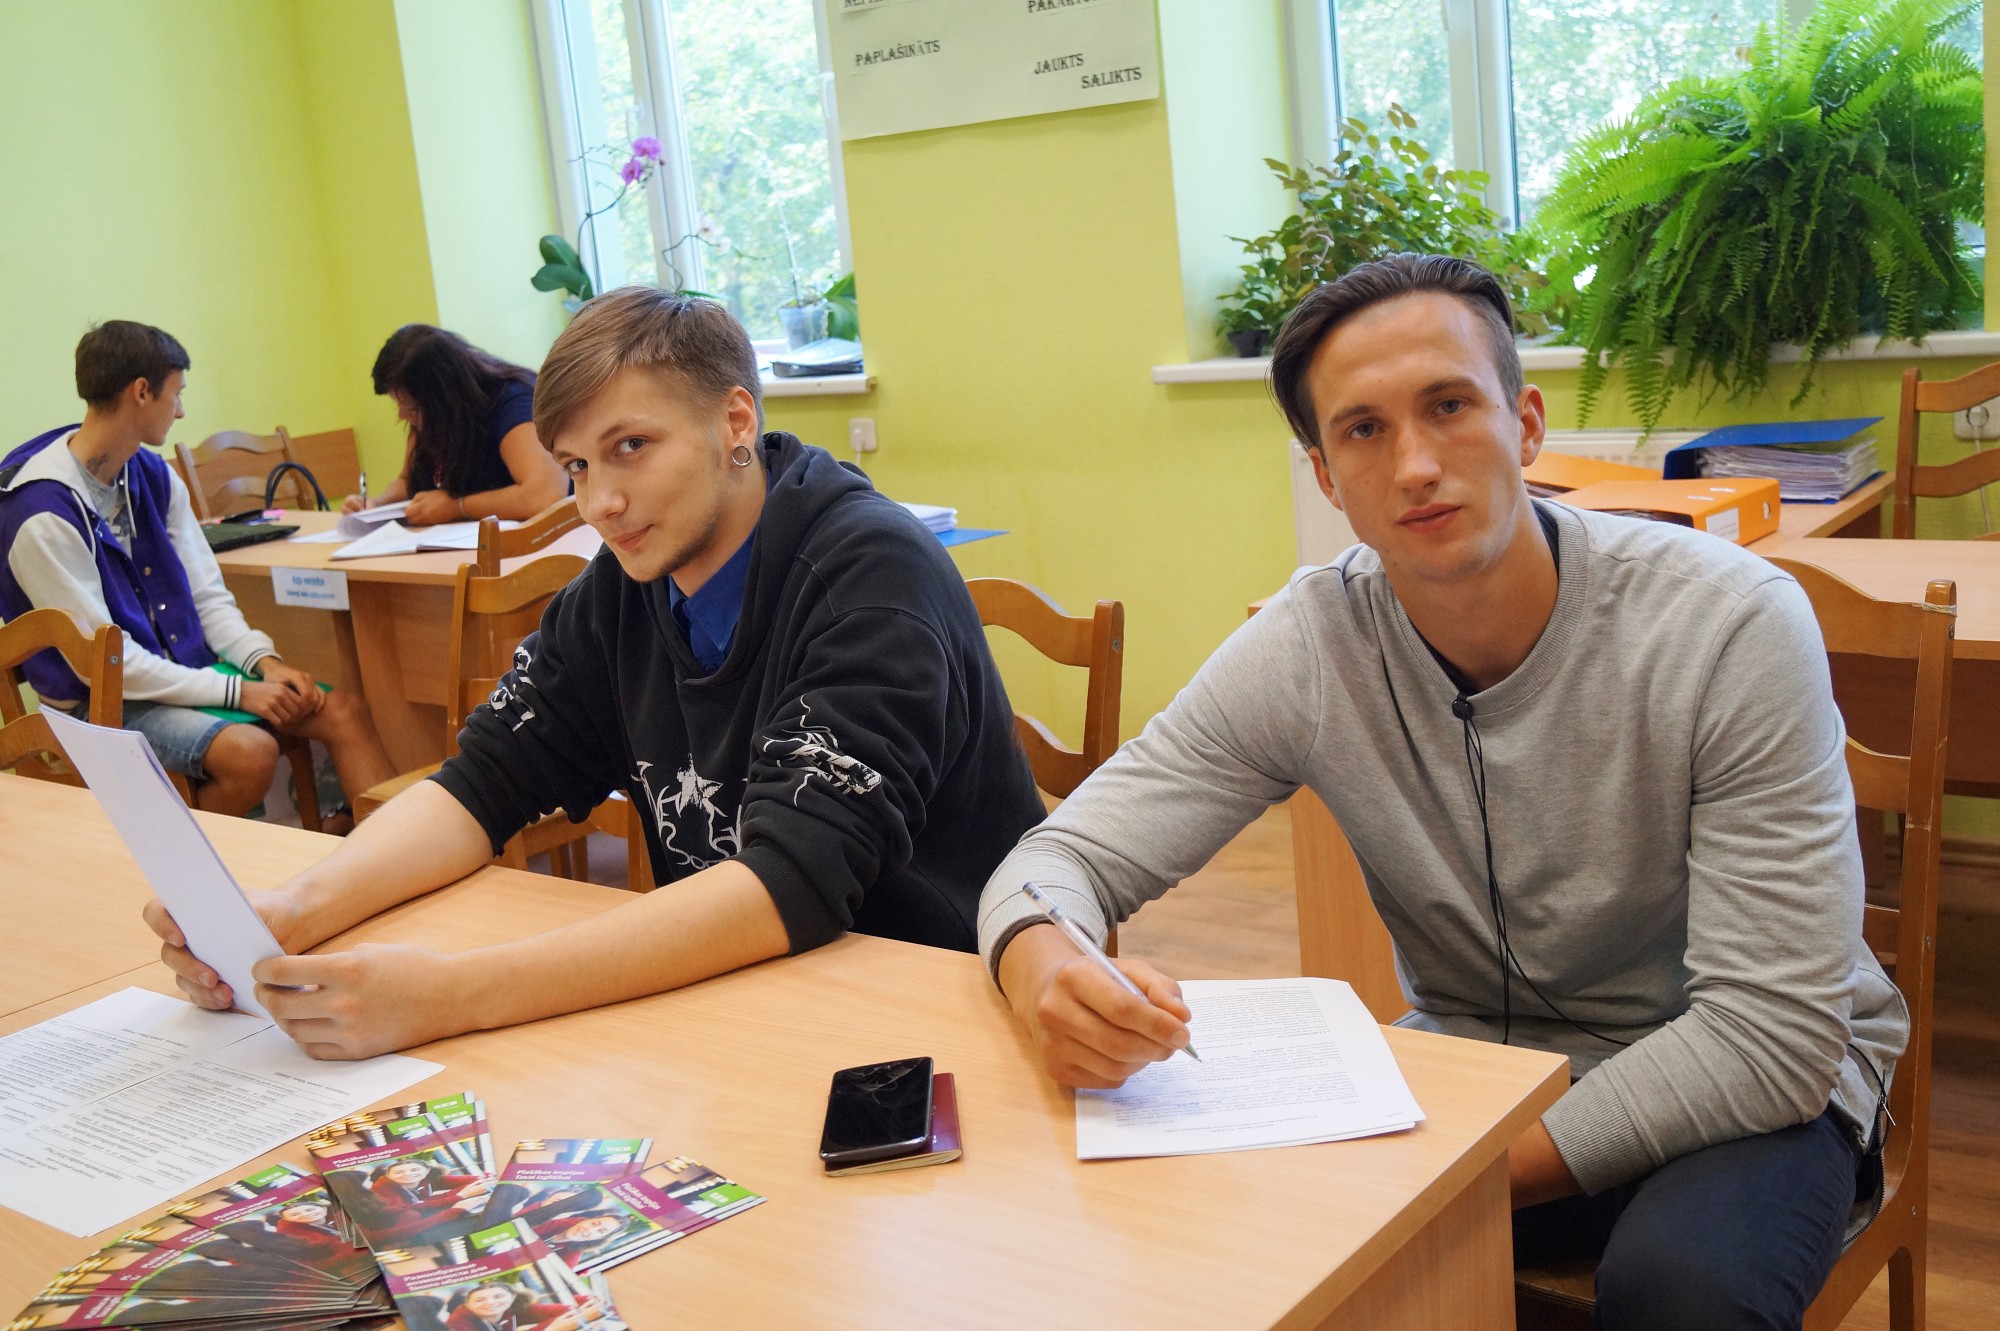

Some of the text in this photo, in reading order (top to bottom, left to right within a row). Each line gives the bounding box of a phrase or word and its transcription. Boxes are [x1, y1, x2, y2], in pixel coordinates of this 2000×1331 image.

[855, 40, 941, 67] PAPLAŠINĀTS
[1034, 53, 1084, 74] JAUKTS
[1081, 67, 1142, 89] SALIKTS
